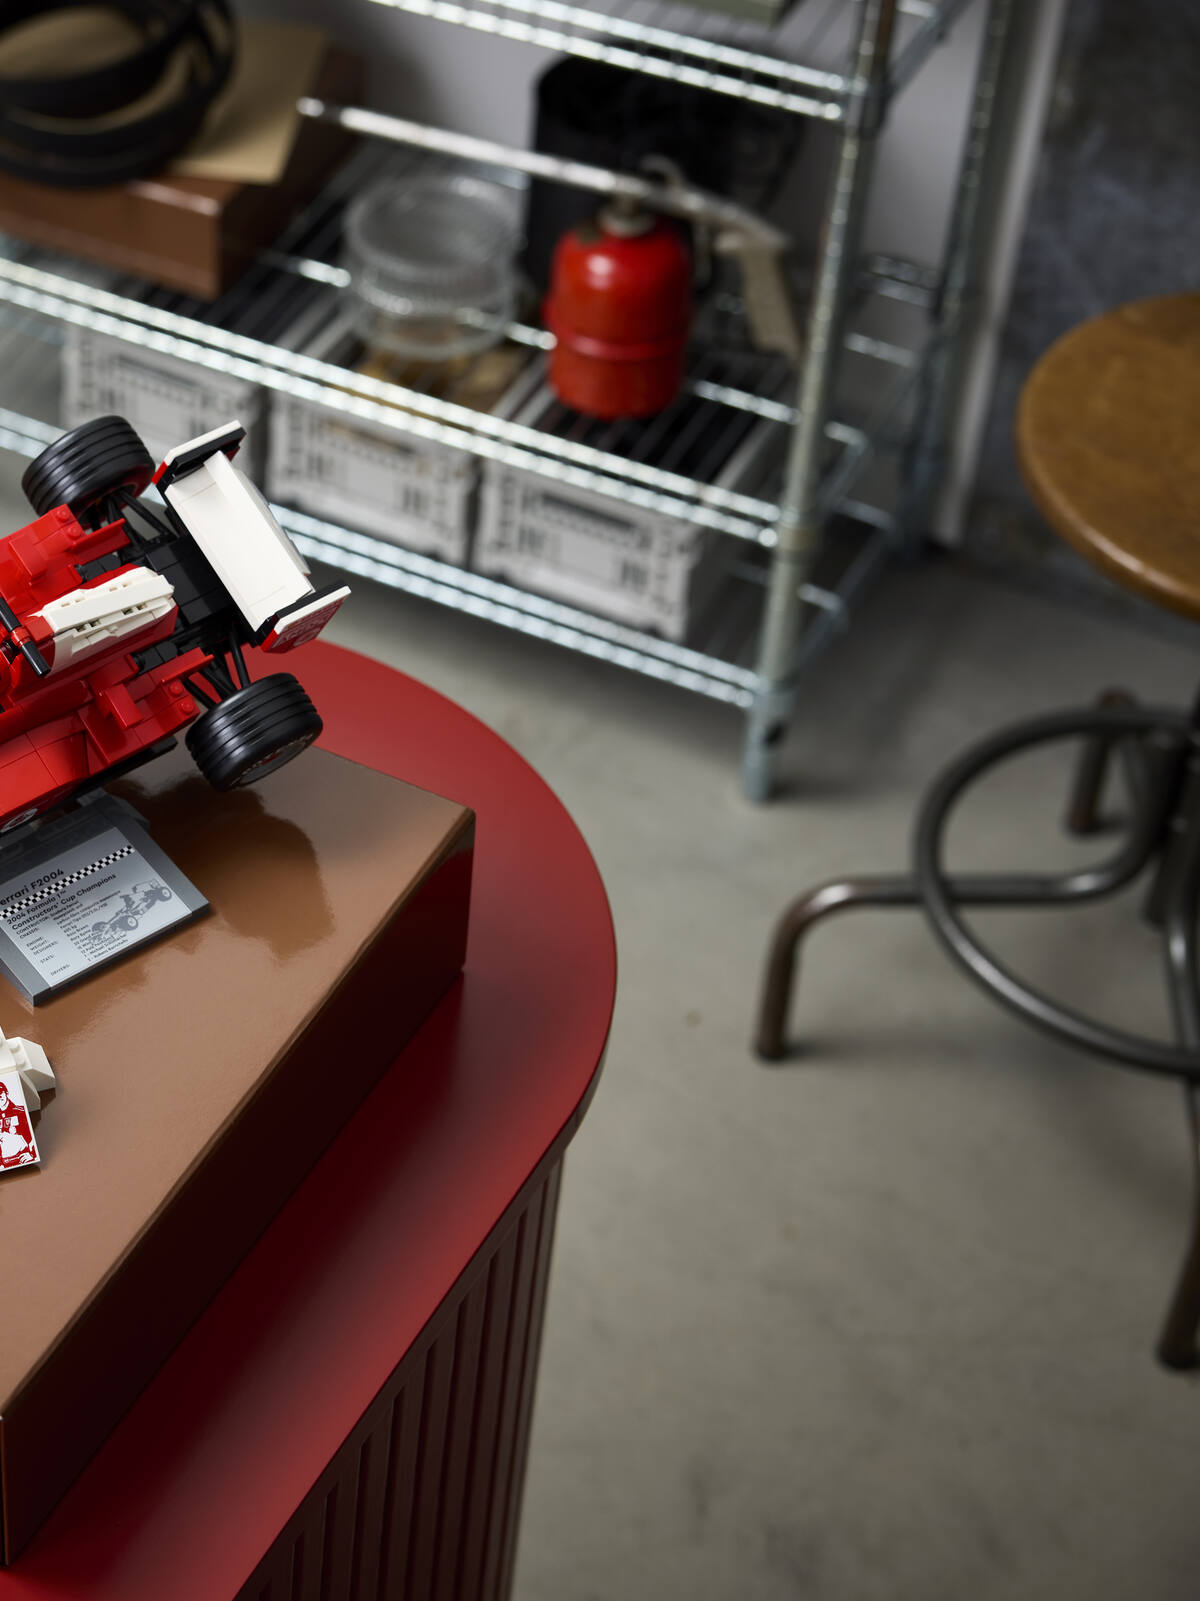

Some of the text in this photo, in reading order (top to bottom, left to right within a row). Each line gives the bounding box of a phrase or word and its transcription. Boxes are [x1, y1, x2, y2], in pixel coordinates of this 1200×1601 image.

[30, 868, 63, 889] F2004
[61, 894, 76, 905] Cup
[76, 873, 116, 897] Champions
[6, 912, 25, 924] 2004
[26, 896, 55, 914] Formula
